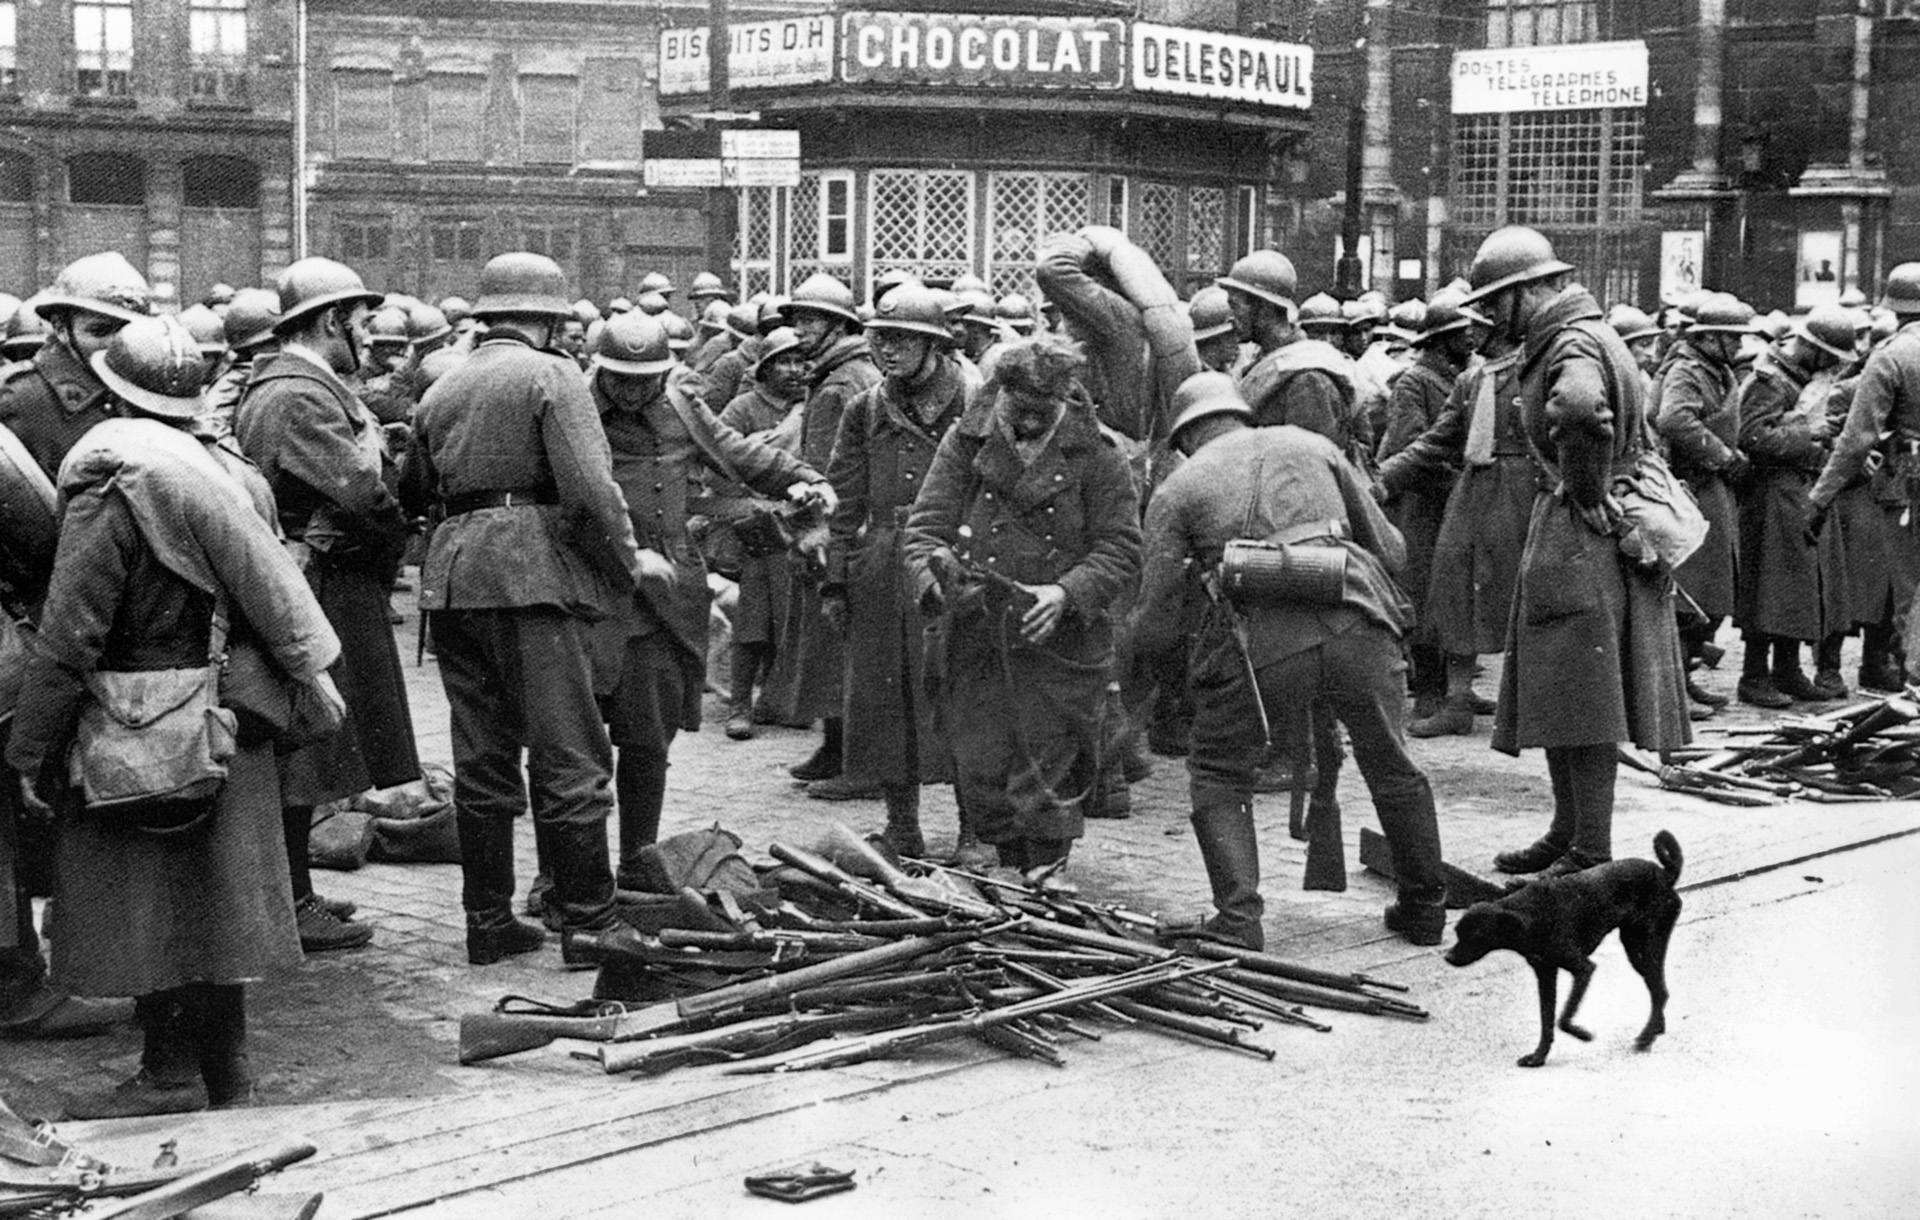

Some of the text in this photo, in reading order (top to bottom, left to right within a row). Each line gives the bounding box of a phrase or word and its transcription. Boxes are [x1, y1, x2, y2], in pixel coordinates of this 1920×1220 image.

[666, 28, 771, 60] BISITS
[857, 26, 1110, 74] CHOCOLAT
[1143, 36, 1307, 97] DELESPAUL
[1459, 58, 1531, 76] POSTES
[1488, 70, 1618, 91] TELEGRAPHES
[1531, 85, 1644, 106] TELEPHONE
